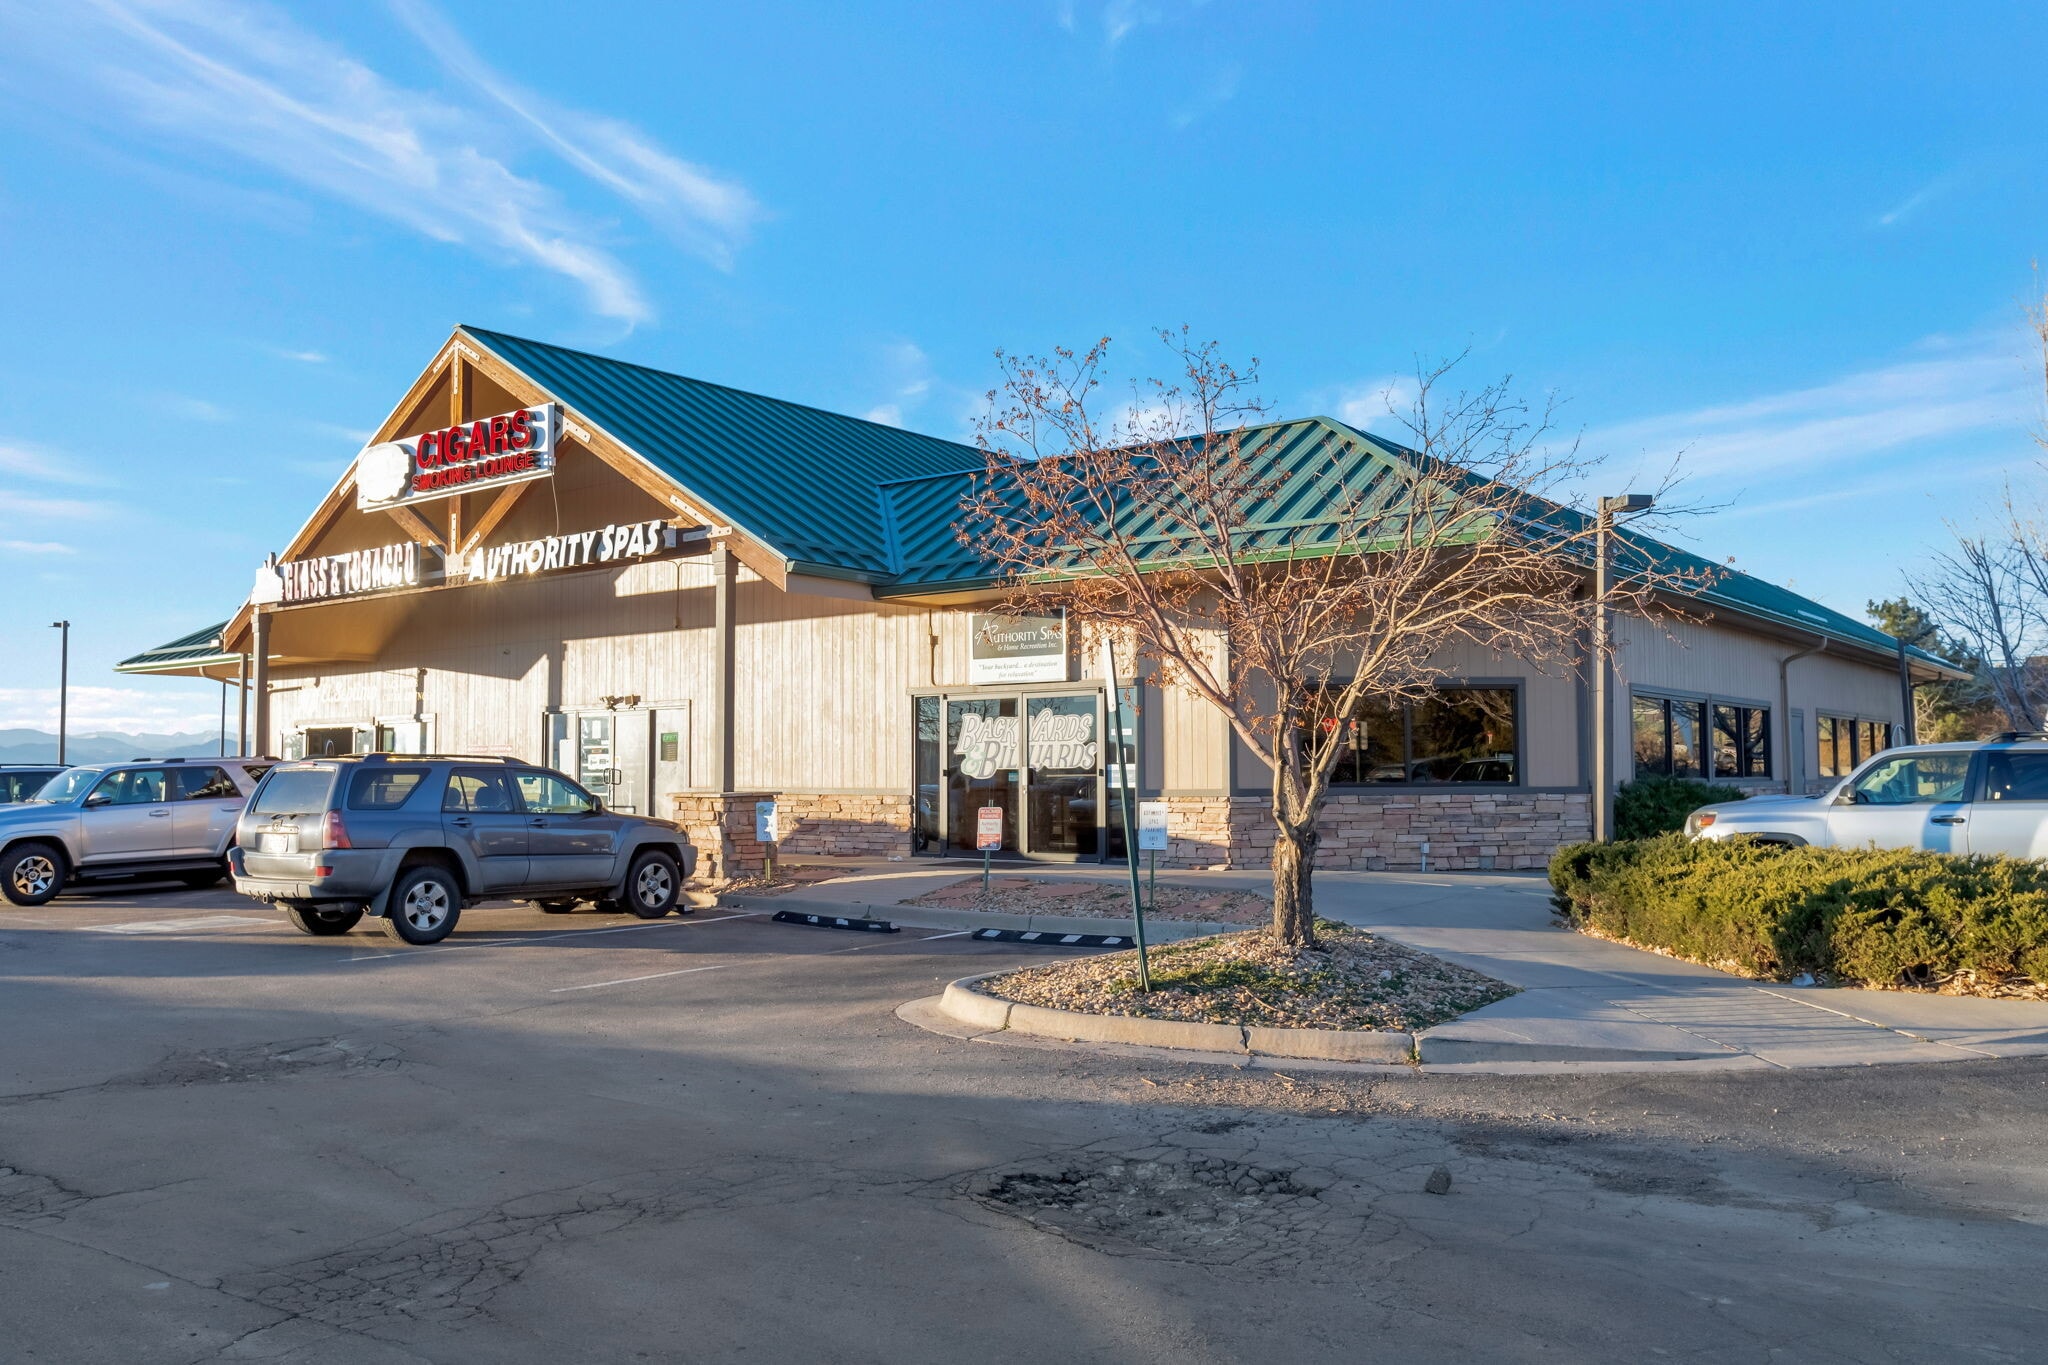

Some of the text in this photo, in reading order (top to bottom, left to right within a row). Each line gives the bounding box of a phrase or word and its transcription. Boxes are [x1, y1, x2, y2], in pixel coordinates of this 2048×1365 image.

[416, 409, 536, 469] CIGARS
[412, 451, 536, 492] SMOKING LOUNGE
[284, 541, 415, 602] GLASS & TOBACCO
[468, 519, 662, 582] AUTHORITY SPAS
[1004, 643, 1019, 651] Home
[1020, 641, 1047, 650] Recreation
[1040, 626, 1063, 640] SPAS
